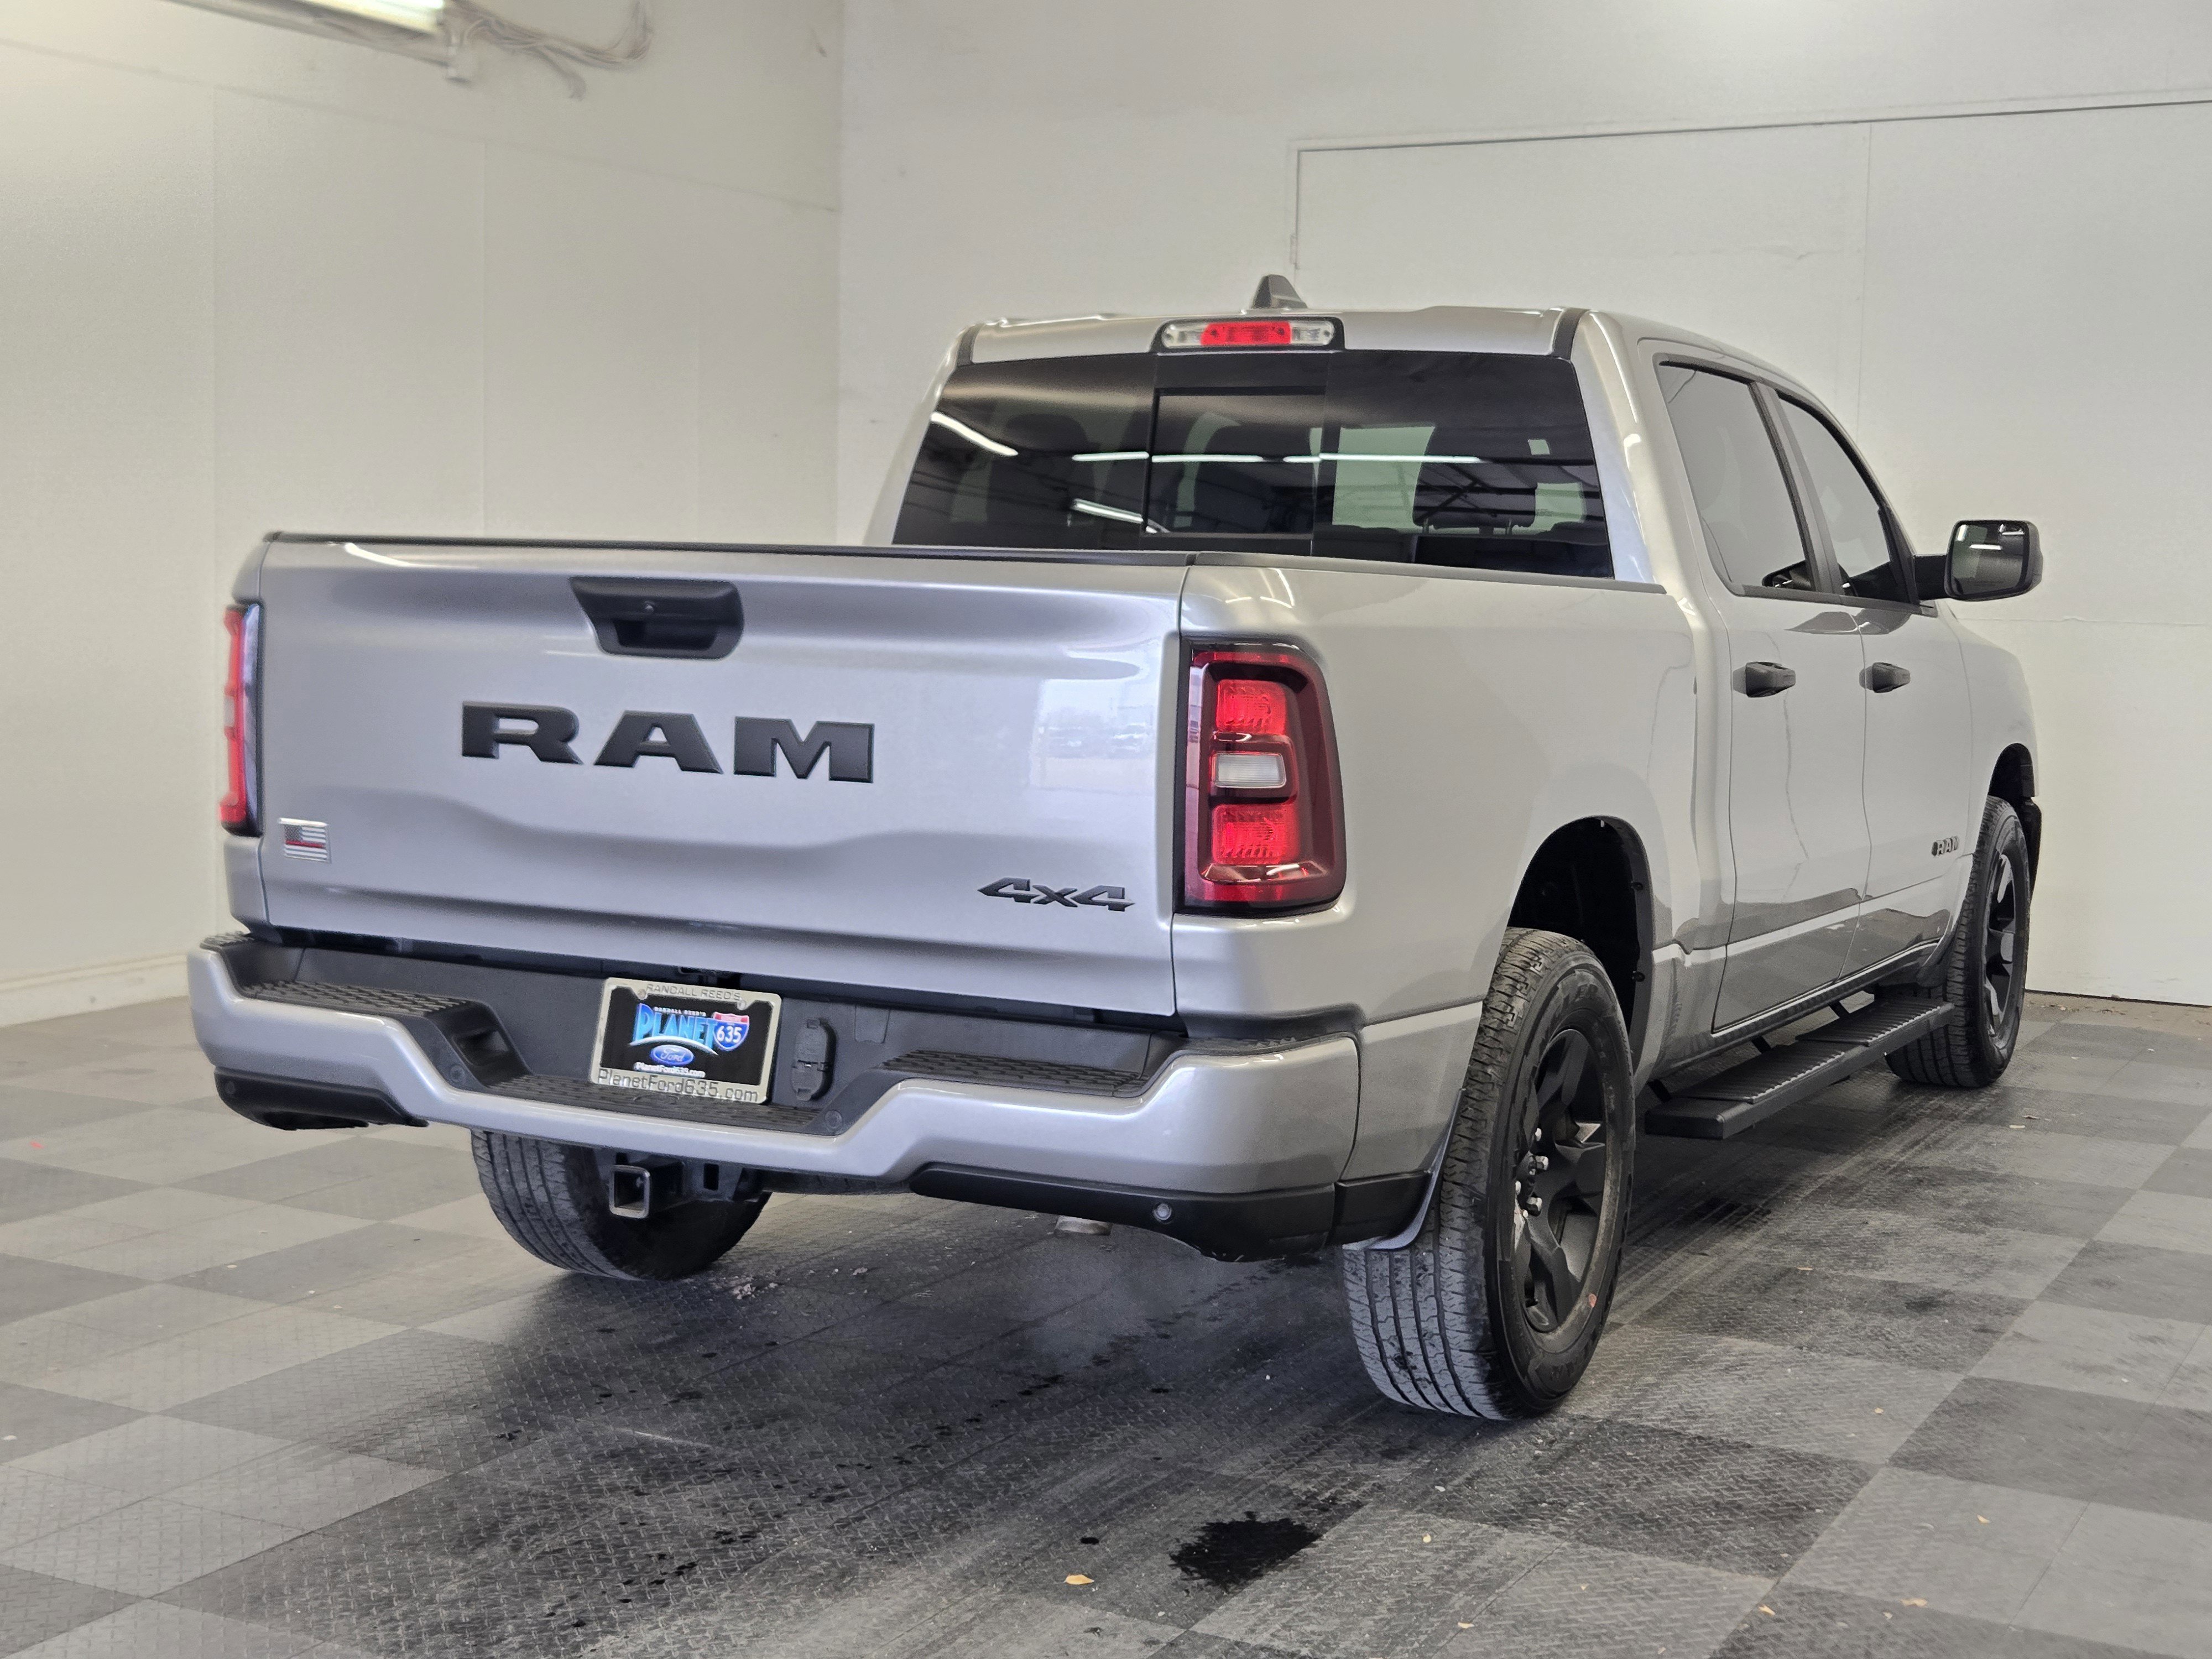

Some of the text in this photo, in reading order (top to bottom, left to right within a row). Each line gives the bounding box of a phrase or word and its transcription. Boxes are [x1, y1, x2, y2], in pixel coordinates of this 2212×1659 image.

[462, 701, 875, 783] RAM
[1932, 835, 1959, 856] RAM
[646, 984, 740, 1000] RANDALL REED'S
[633, 1003, 718, 1049] PLANET
[716, 1025, 743, 1043] 635
[660, 1048, 686, 1062] Ford
[598, 1068, 759, 1102] PlanetFord635.com
